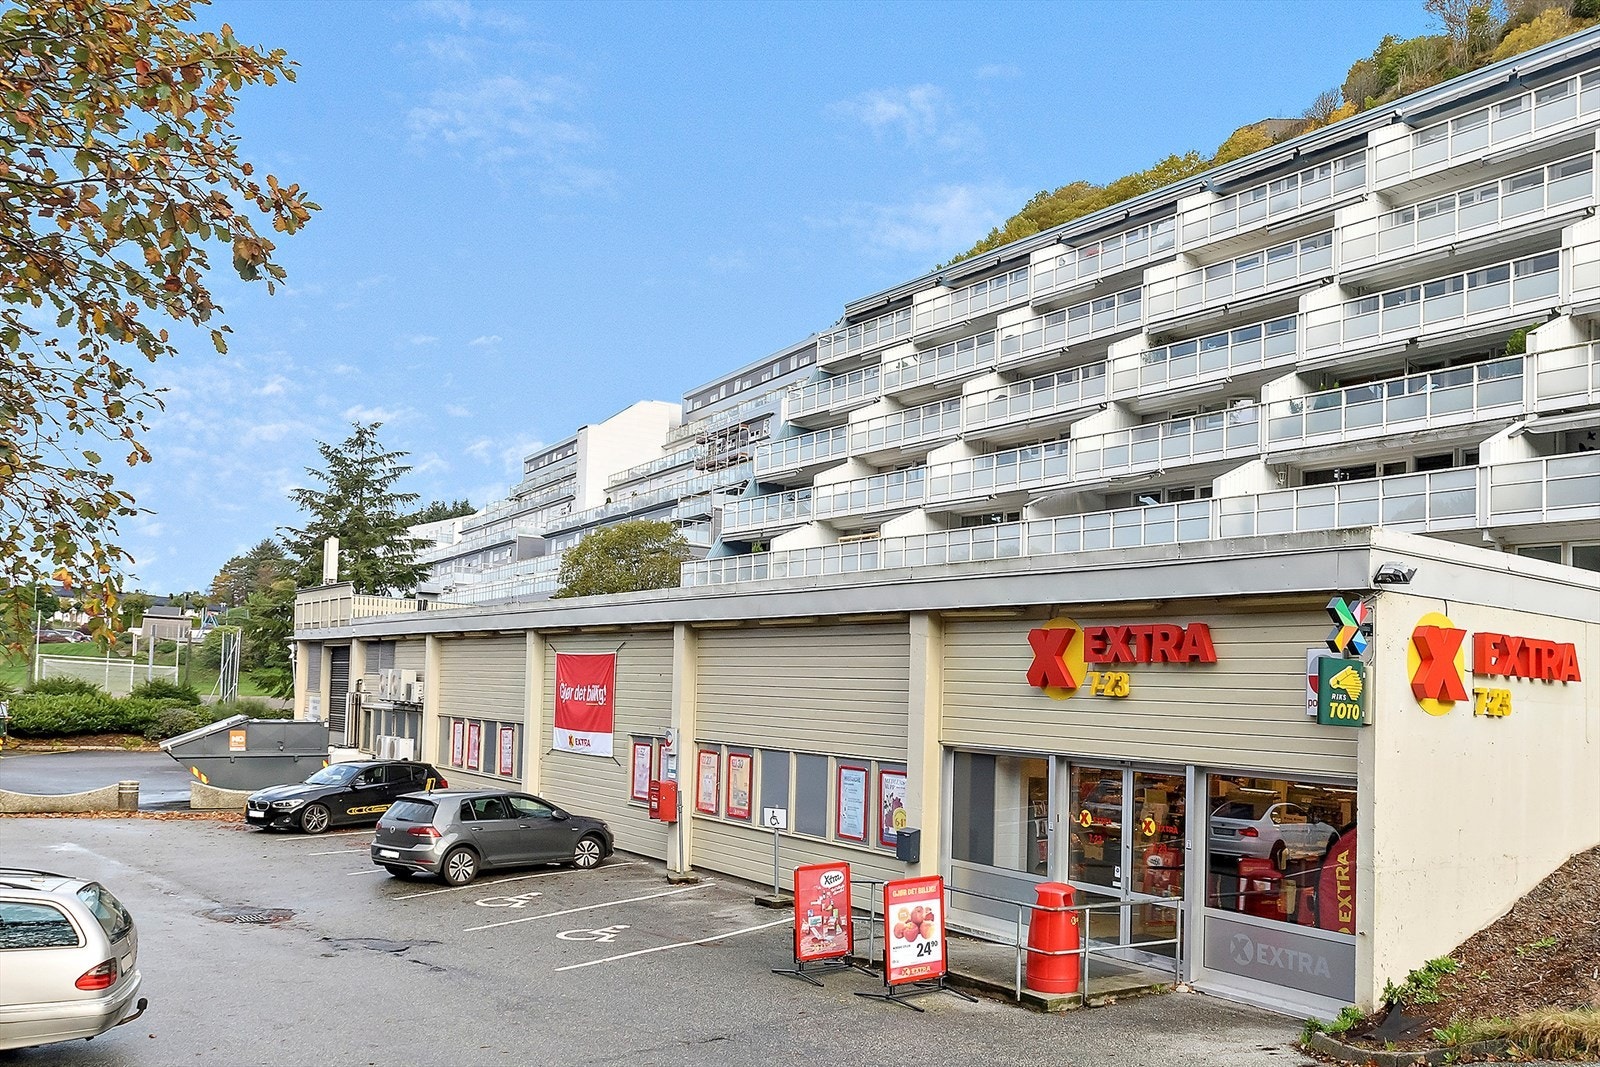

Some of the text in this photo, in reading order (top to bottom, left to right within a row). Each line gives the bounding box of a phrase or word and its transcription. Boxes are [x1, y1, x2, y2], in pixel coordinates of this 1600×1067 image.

[1084, 623, 1217, 664] EXTRA
[1474, 632, 1581, 682] EXTRA
[574, 684, 586, 701] det
[1089, 672, 1130, 697] 7-23
[1331, 693, 1347, 701] RIKS
[1329, 702, 1360, 720] TOTO
[1474, 687, 1512, 716] 7-23
[575, 738, 591, 747] EXTRA
[824, 874, 842, 885] Xtra
[1336, 849, 1353, 923] EXTRA
[1256, 943, 1331, 978] EXTRA
